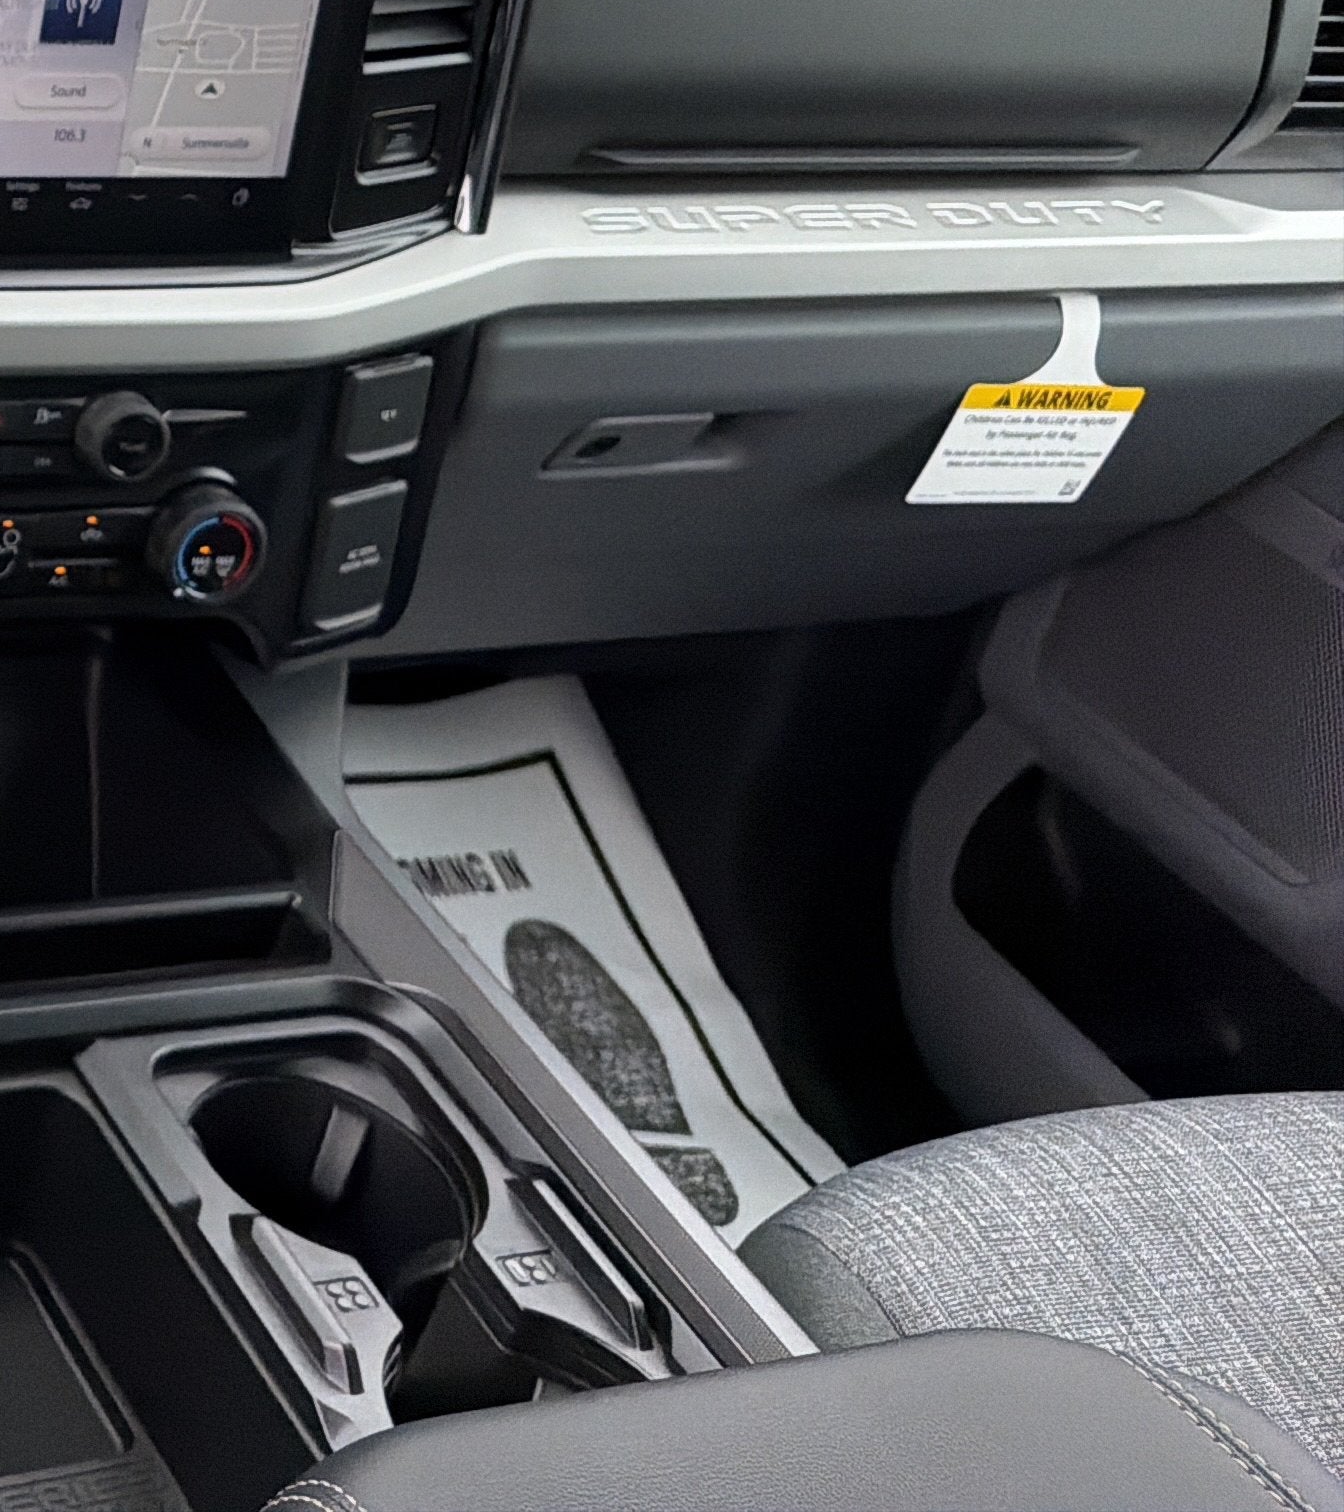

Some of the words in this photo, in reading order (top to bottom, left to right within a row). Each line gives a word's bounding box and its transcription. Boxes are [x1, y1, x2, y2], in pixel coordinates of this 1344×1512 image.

[49, 86, 87, 98] Sound
[580, 201, 918, 234] SUPER
[924, 197, 1165, 228] DUTY
[1016, 388, 1113, 410] WARNING
[487, 848, 533, 892] IN
